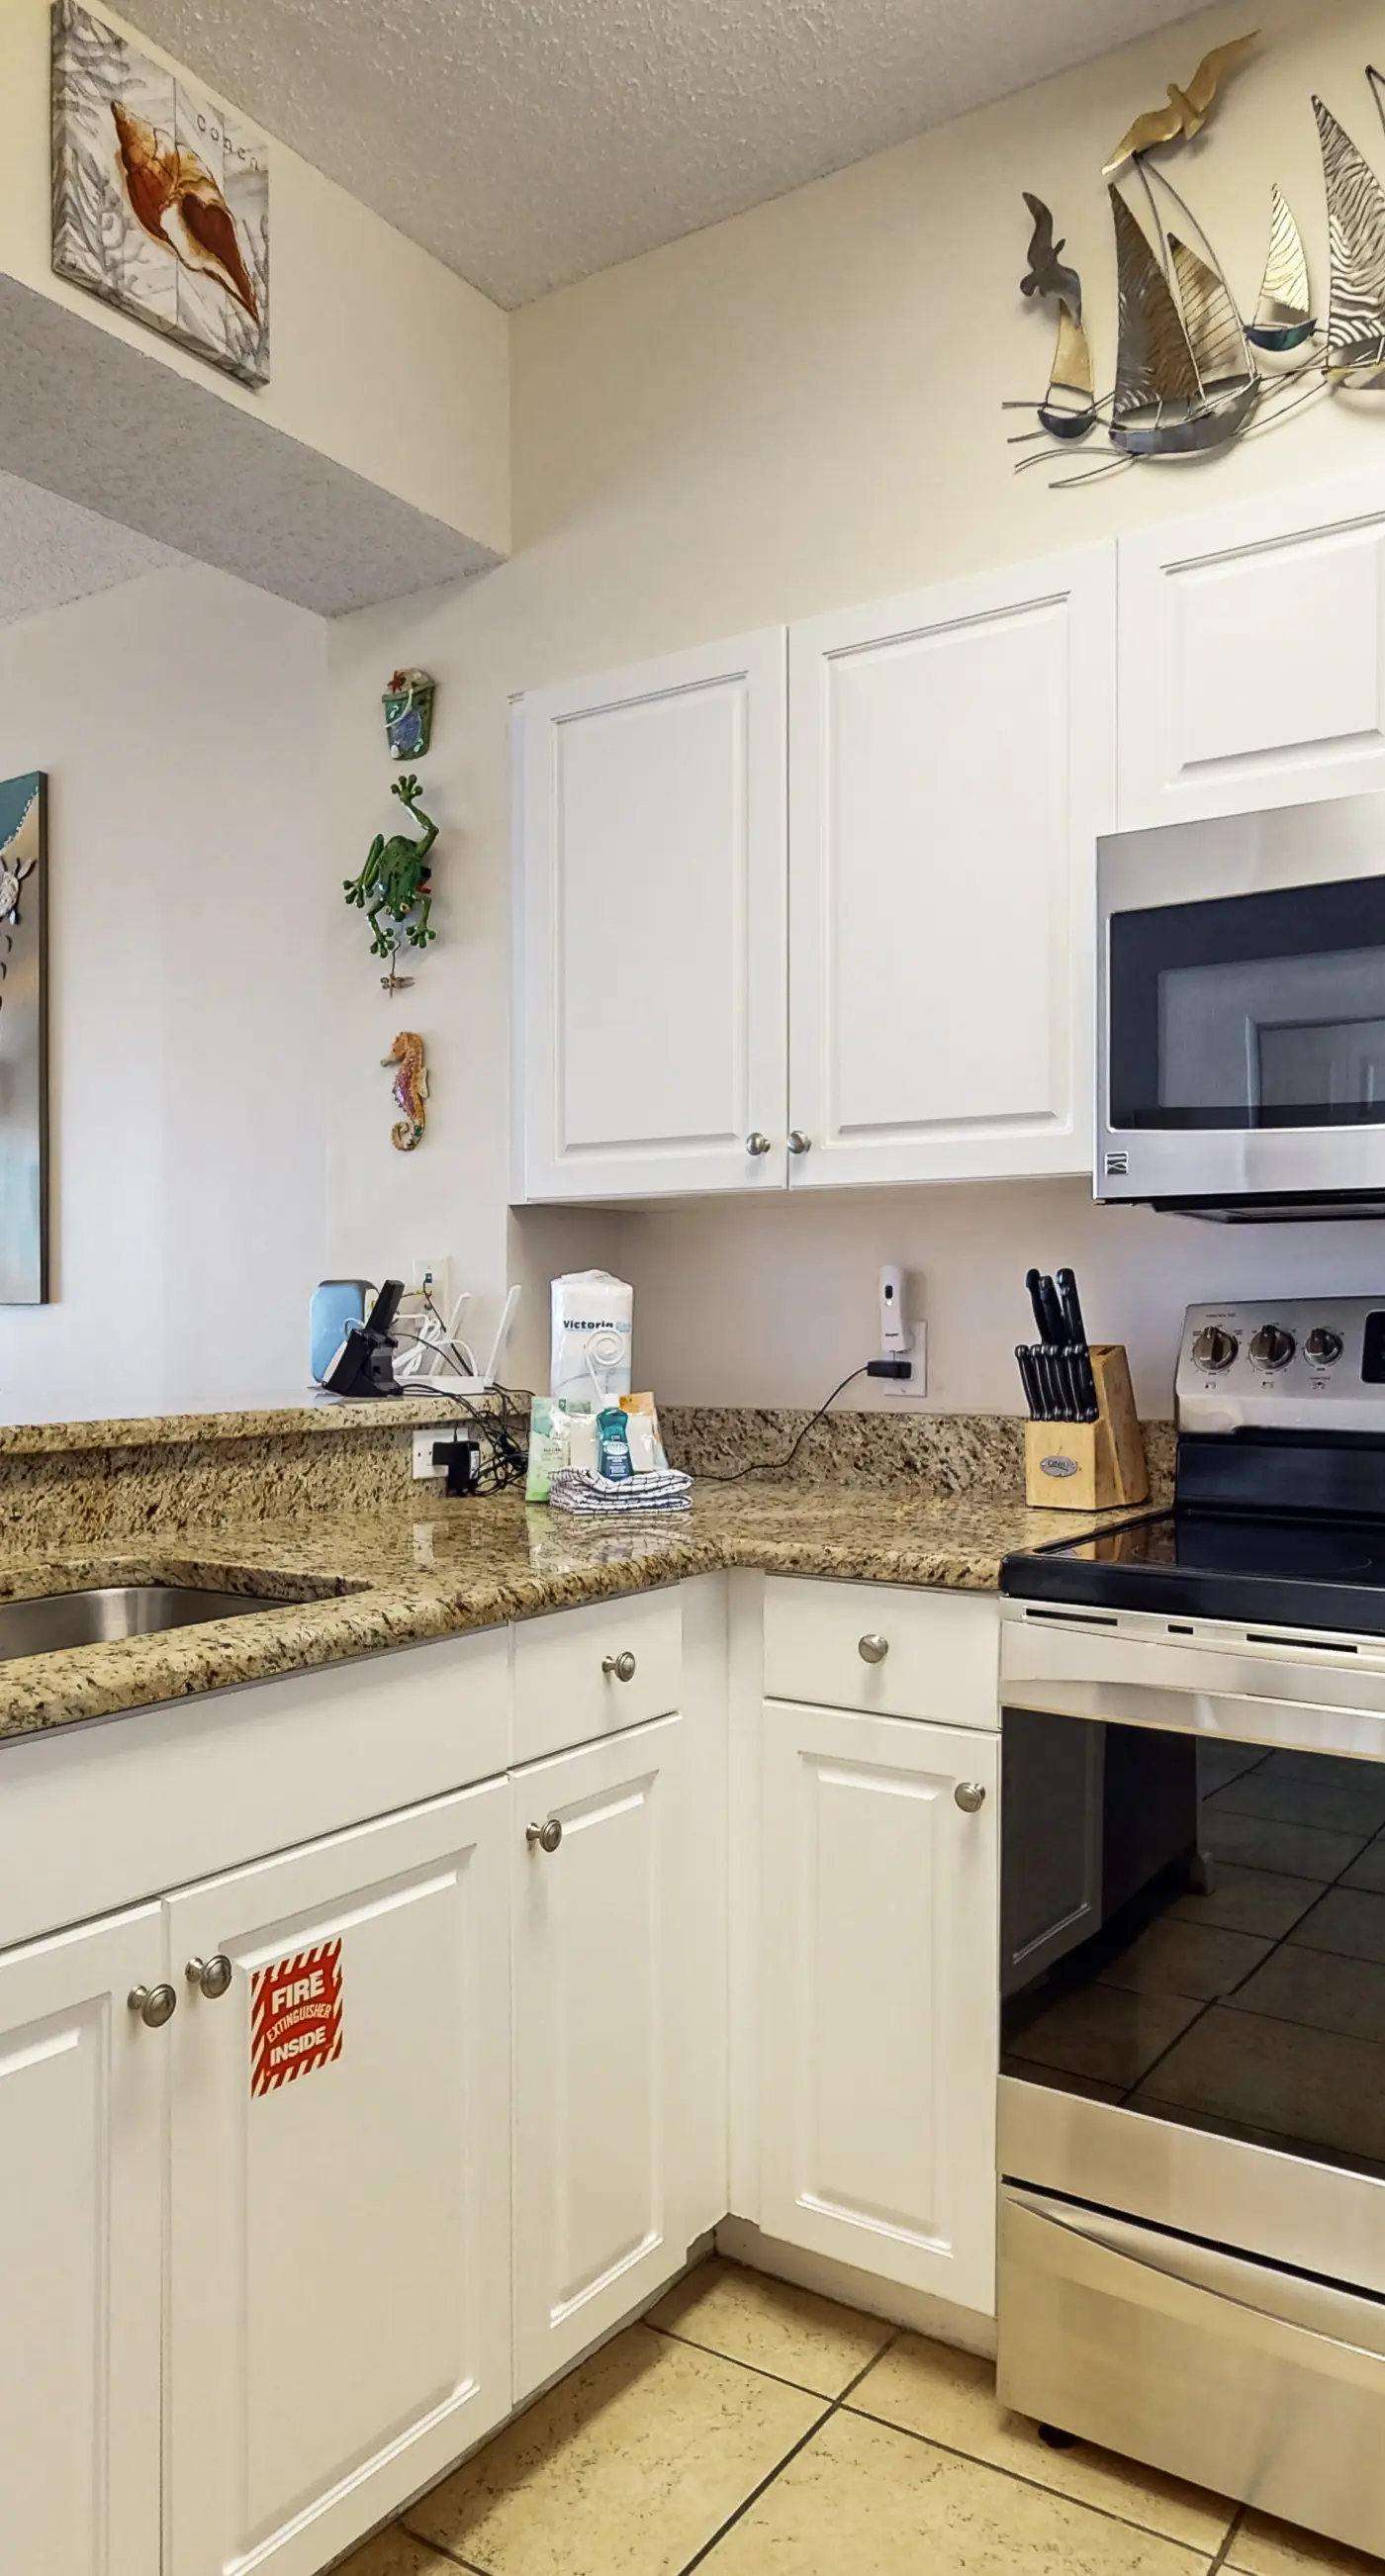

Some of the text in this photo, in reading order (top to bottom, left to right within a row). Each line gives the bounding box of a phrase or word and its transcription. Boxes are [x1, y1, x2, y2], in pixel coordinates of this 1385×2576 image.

[271, 1969, 325, 2015] FIRE
[266, 2003, 331, 2043] EXTINGUISHER
[270, 2026, 326, 2067] INSIDE
